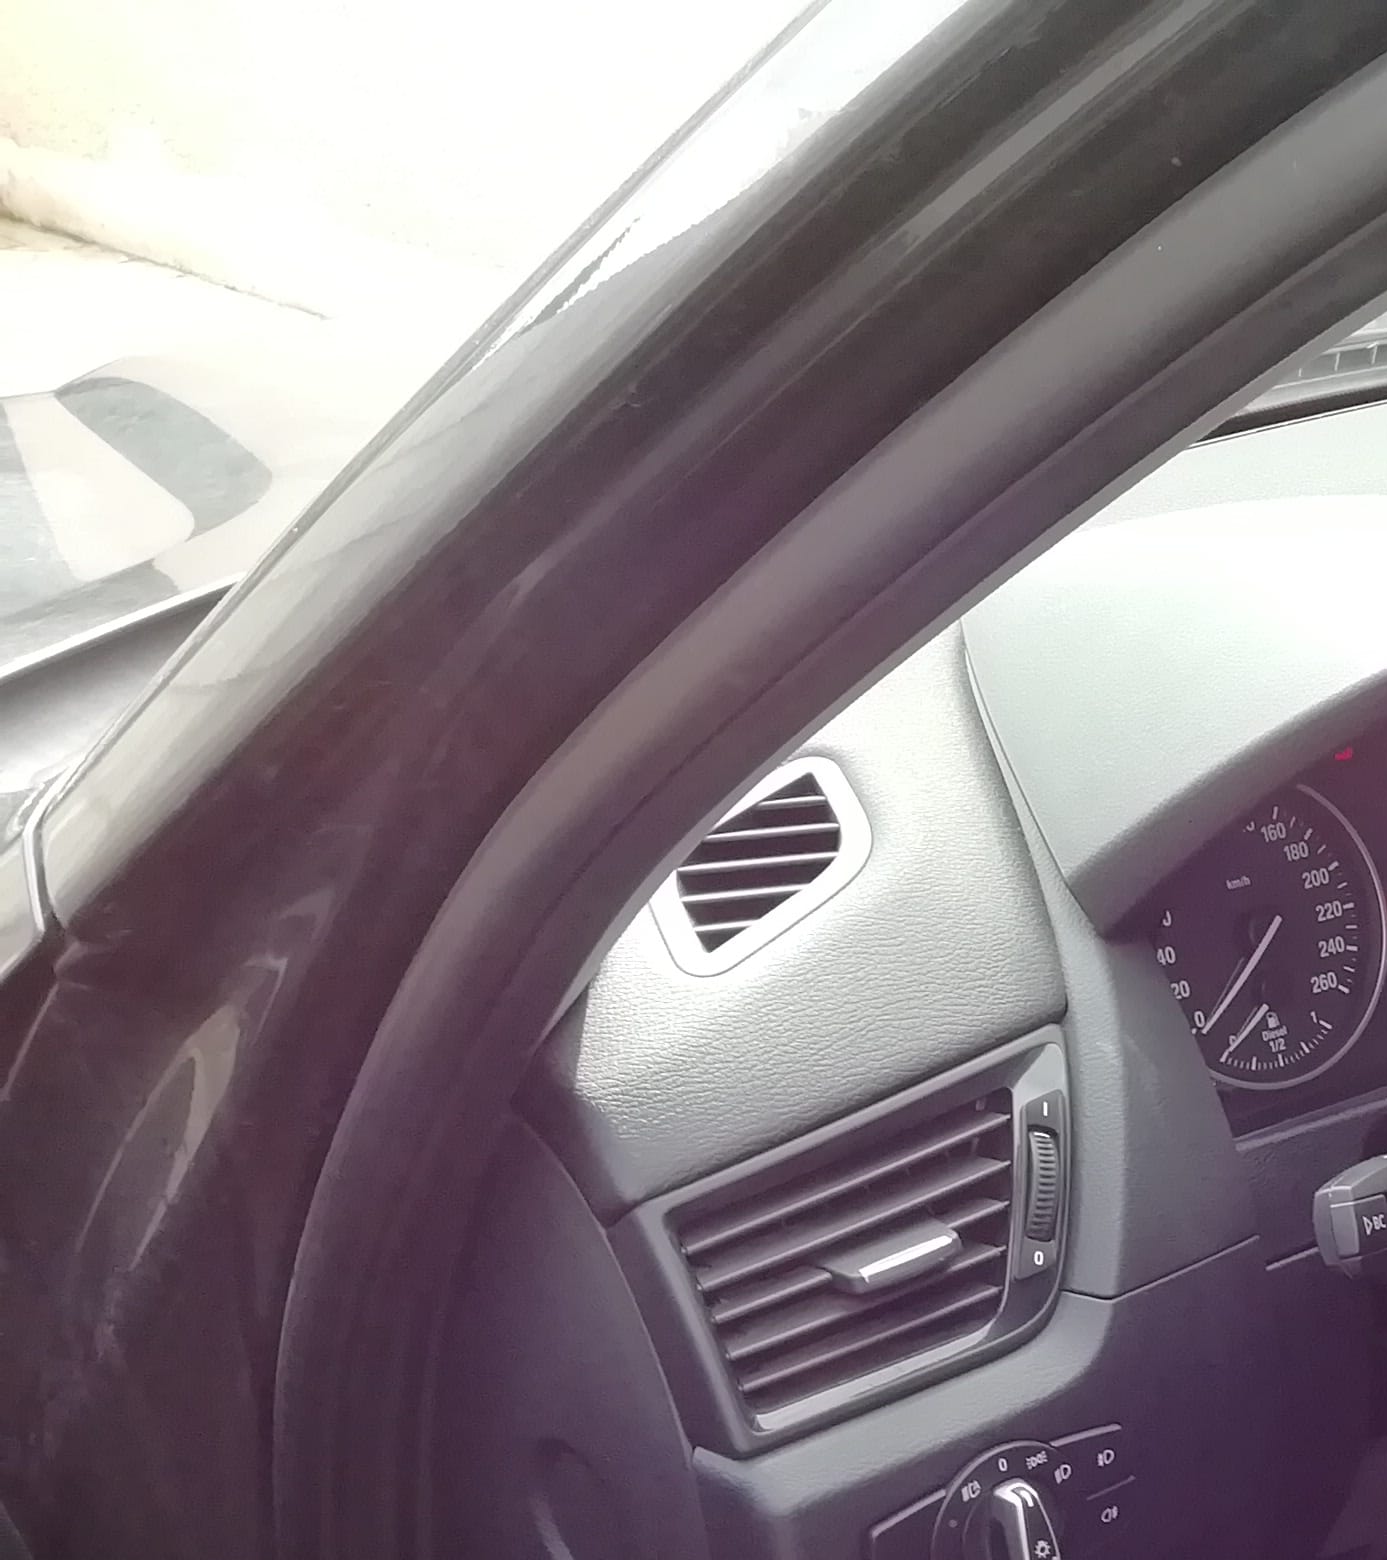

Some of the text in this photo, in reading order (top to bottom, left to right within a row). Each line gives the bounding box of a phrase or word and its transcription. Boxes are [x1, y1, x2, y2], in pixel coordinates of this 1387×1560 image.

[1260, 822, 1287, 843] 160
[1283, 841, 1309, 863] 180
[1226, 875, 1251, 891] km/h
[1301, 867, 1330, 890] 200
[1315, 900, 1343, 922] 220
[1156, 945, 1177, 966] 40
[1318, 936, 1345, 958] 240
[1170, 980, 1191, 1000] 20
[1310, 972, 1338, 994] 260
[1194, 1010, 1206, 1028] 0
[1261, 1026, 1288, 1042] Diesel
[1269, 1039, 1287, 1053] 1/2
[1372, 1214, 1386, 1230] BC
